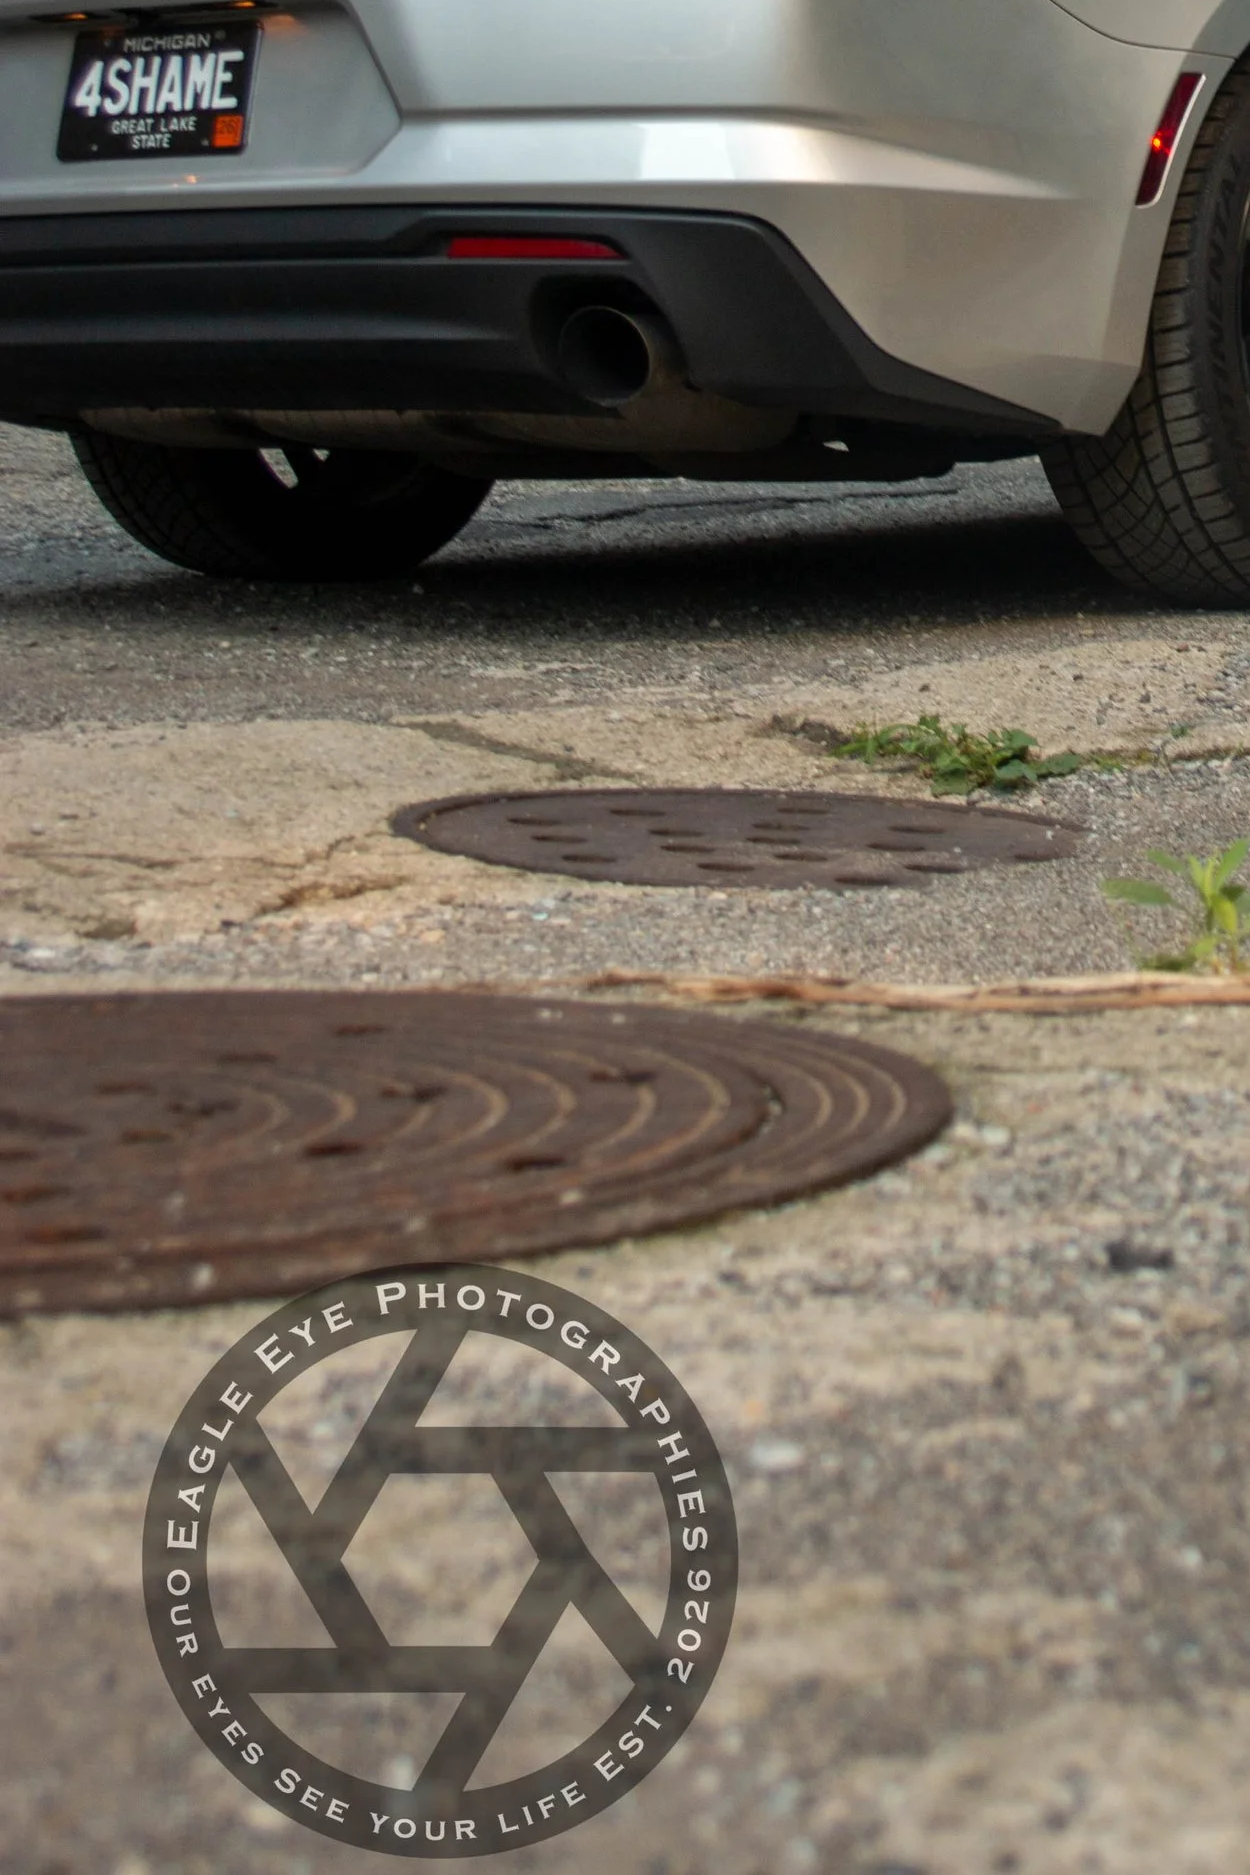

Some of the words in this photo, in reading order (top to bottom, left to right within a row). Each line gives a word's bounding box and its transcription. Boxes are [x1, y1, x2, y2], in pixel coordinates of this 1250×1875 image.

[123, 32, 211, 53] MICHIGAN
[74, 49, 245, 117] 4SHAME
[112, 117, 154, 135] GREAT
[159, 116, 197, 132] LAKE
[131, 133, 171, 150] STATE
